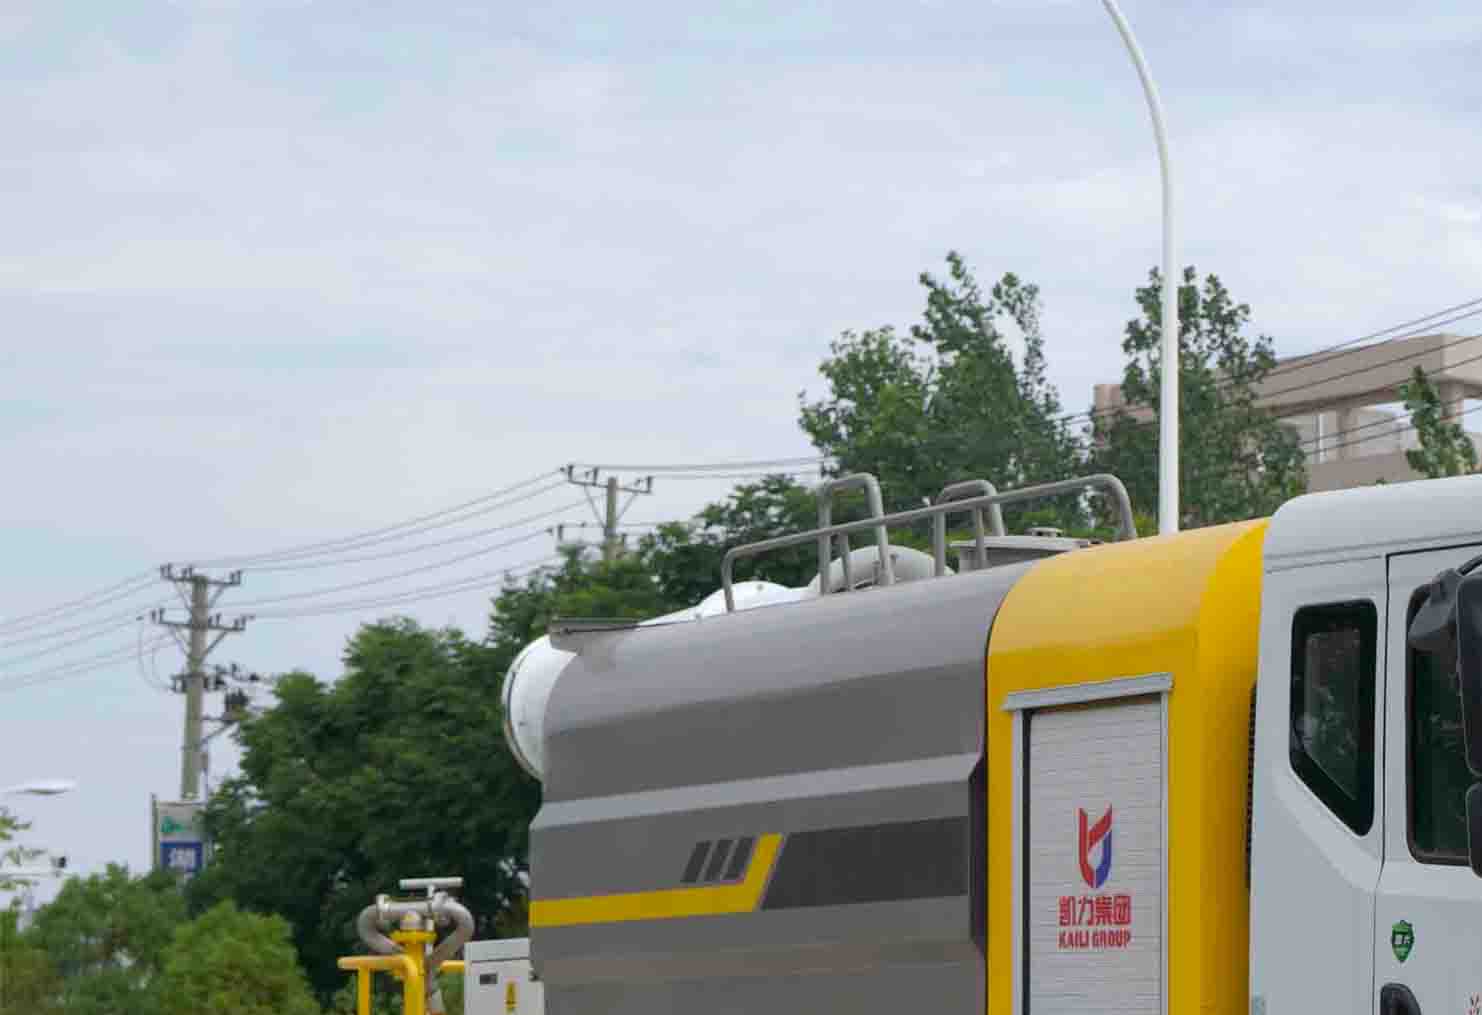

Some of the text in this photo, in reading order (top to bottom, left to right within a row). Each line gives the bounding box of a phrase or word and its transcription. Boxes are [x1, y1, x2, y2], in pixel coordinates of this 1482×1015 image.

[1059, 895, 1131, 926] 凯力集团
[1059, 930, 1131, 949] KAILI GROUP
